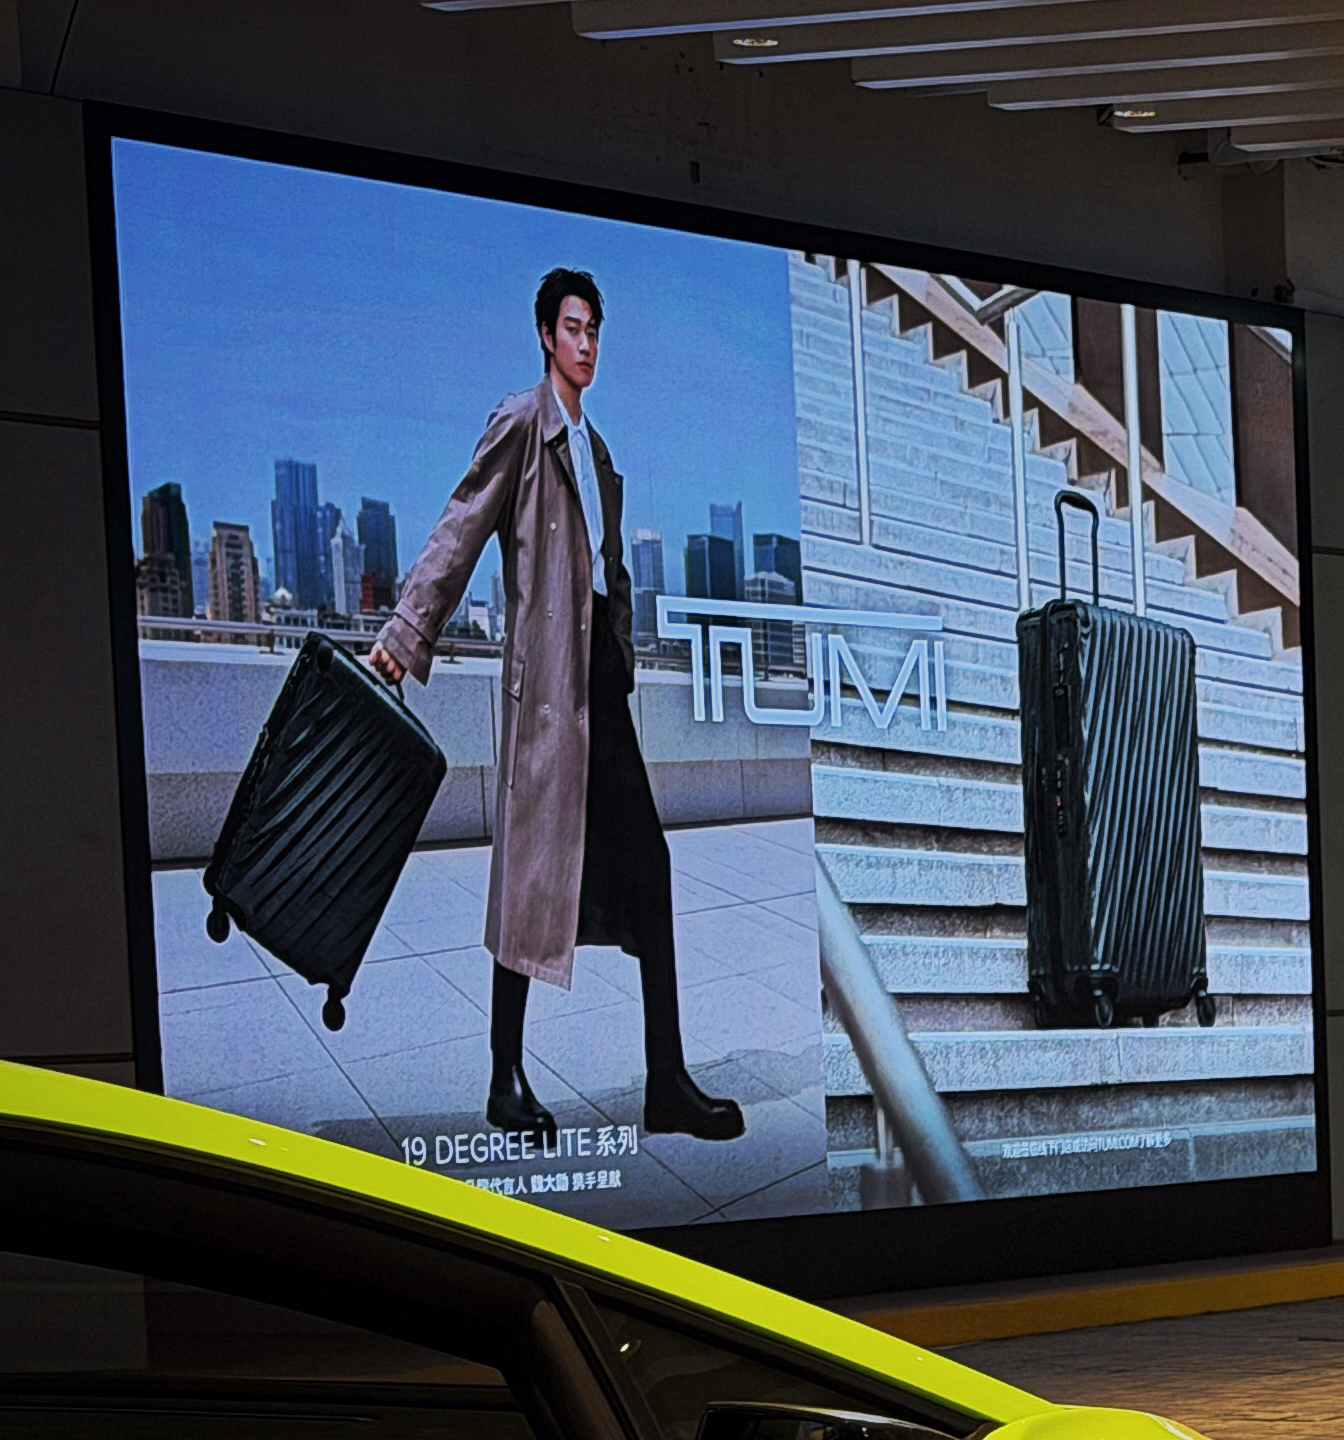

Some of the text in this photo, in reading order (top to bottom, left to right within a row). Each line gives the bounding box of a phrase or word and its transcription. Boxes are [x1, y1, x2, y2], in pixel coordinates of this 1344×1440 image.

[656, 595, 948, 732] TUMI
[402, 1124, 638, 1166] 19 DEGREE LITE 系列
